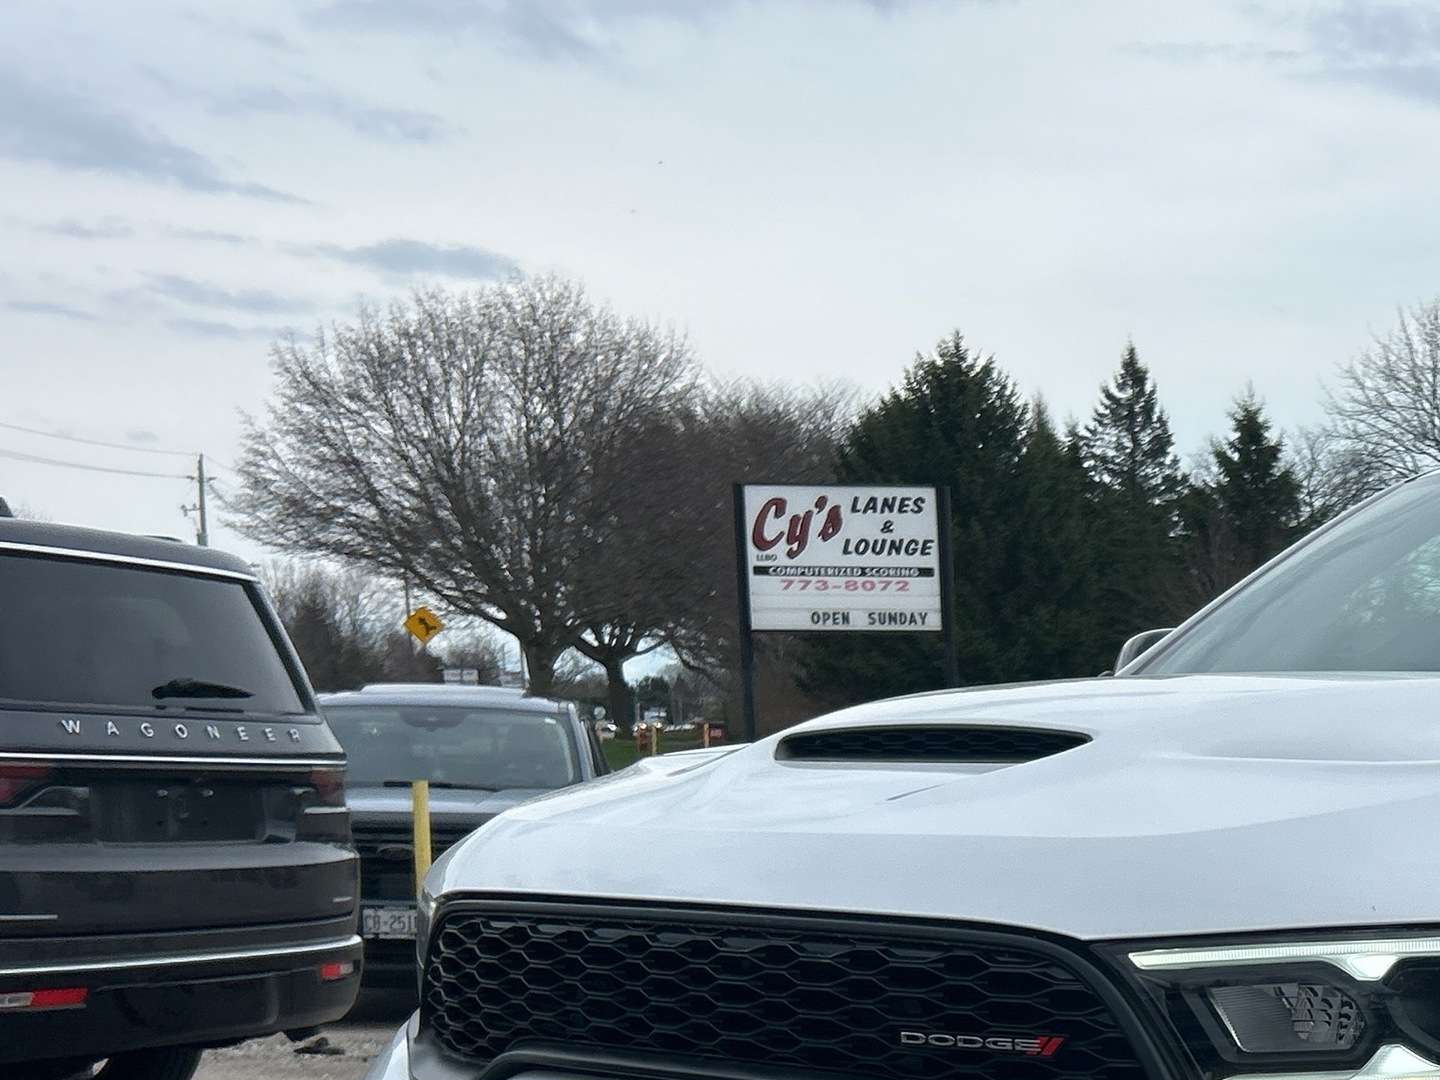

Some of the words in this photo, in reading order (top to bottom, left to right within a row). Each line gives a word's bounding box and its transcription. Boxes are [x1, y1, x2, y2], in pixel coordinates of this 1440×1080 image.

[851, 496, 926, 514] LANES
[752, 495, 843, 559] Cy's
[880, 520, 895, 533] &
[842, 538, 934, 556] LOUNGE
[769, 567, 862, 577] COMPUTERIZED
[865, 567, 919, 577] SCORING
[781, 579, 910, 592] 773-8072
[811, 612, 850, 626] OPEN
[868, 612, 928, 626] SUNDAY
[60, 719, 301, 743] WAGONEER
[900, 1031, 1042, 1052] DODGE
